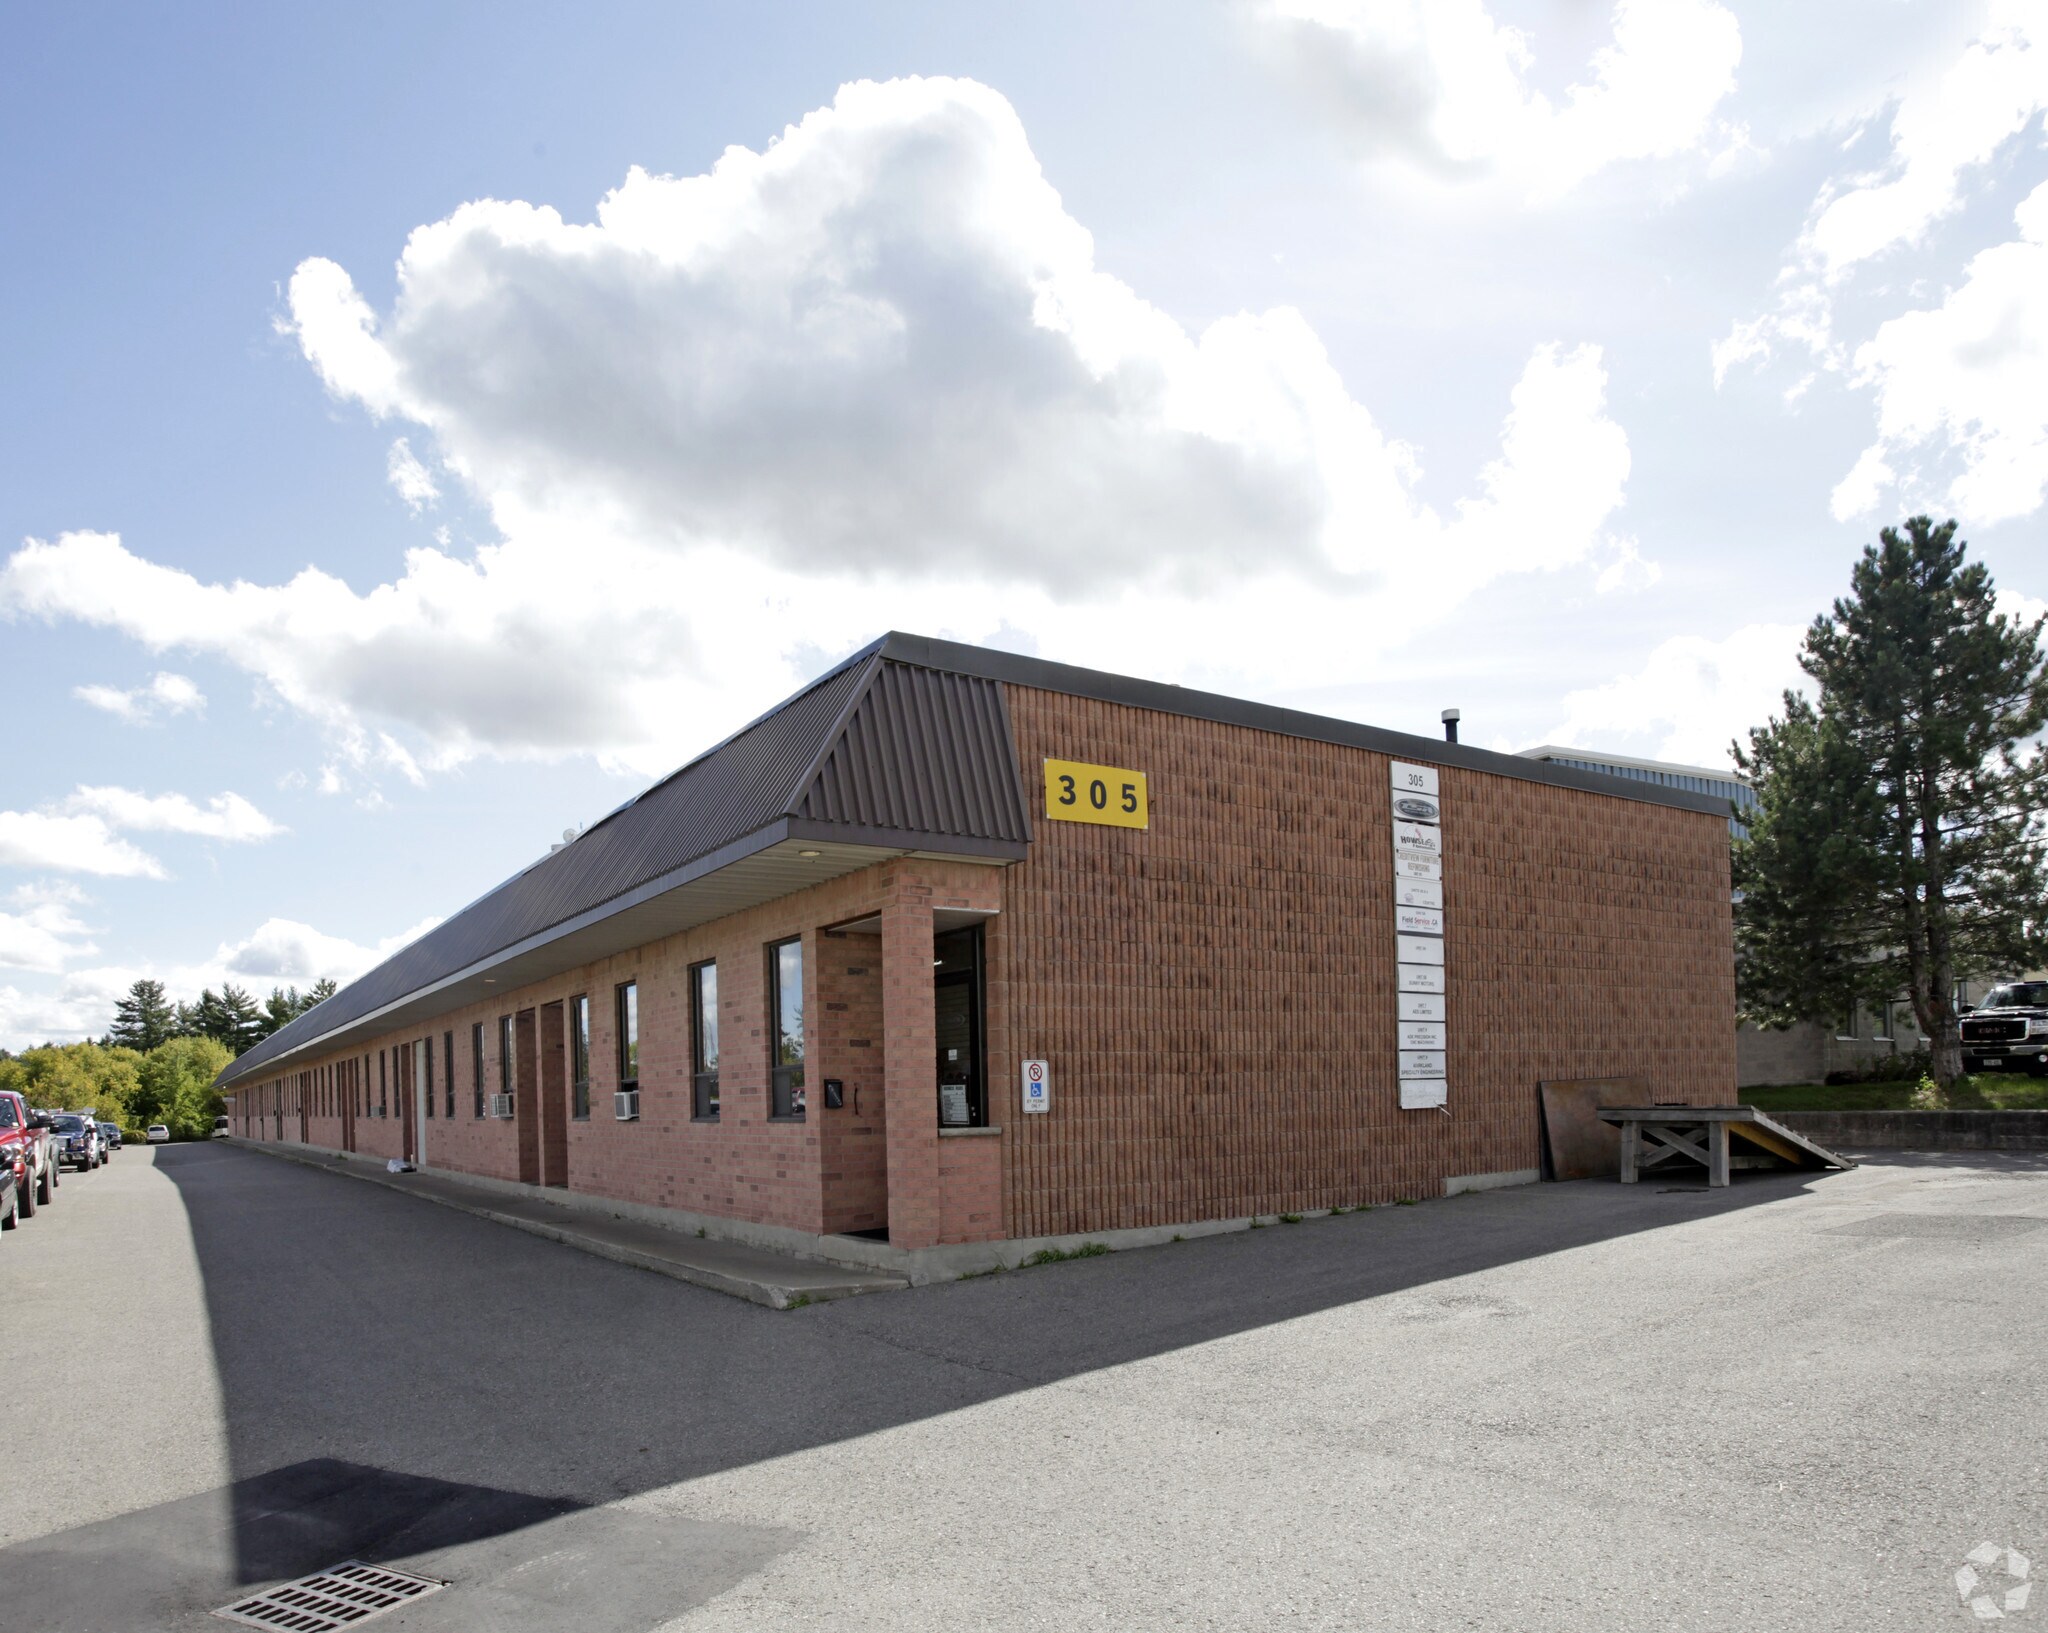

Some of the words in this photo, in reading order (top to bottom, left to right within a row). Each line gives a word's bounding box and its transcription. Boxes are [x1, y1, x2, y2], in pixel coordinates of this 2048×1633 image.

[1408, 773, 1424, 787] 305
[1058, 775, 1138, 813] 305
[1415, 917, 1430, 925] Service
